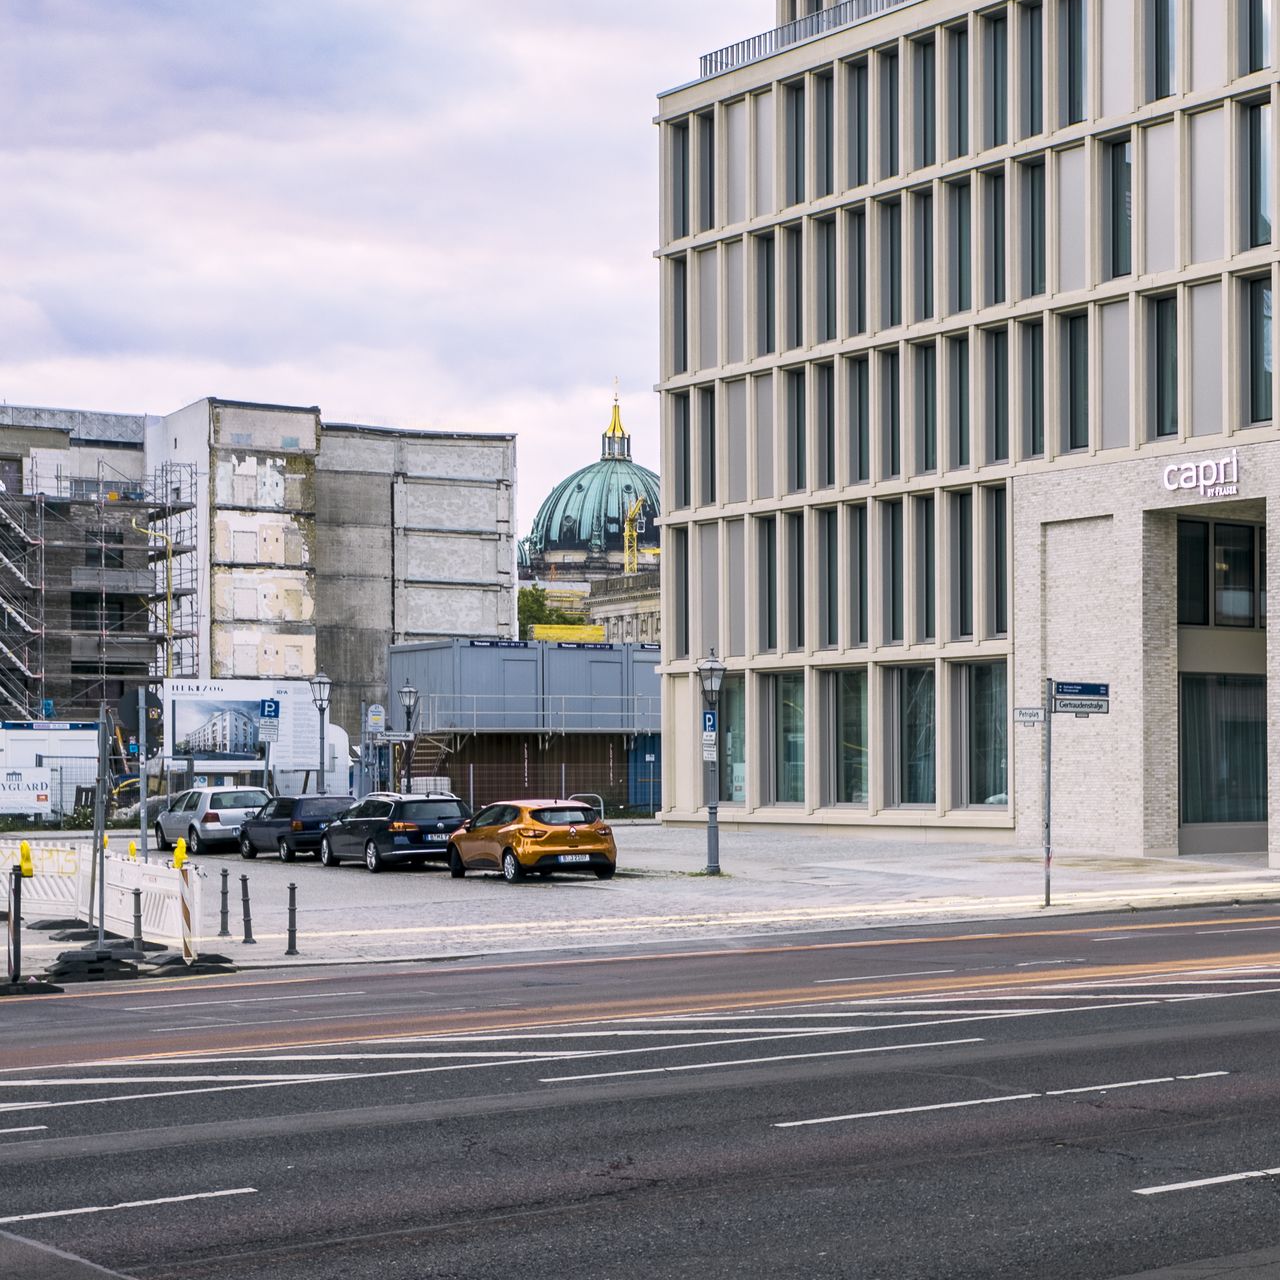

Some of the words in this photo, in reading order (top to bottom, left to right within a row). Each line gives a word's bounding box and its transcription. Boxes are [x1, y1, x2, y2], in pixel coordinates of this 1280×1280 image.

[1163, 448, 1238, 495] capri
[1060, 701, 1103, 710] Gertraudenstraße
[1019, 710, 1040, 718] Petriplatz
